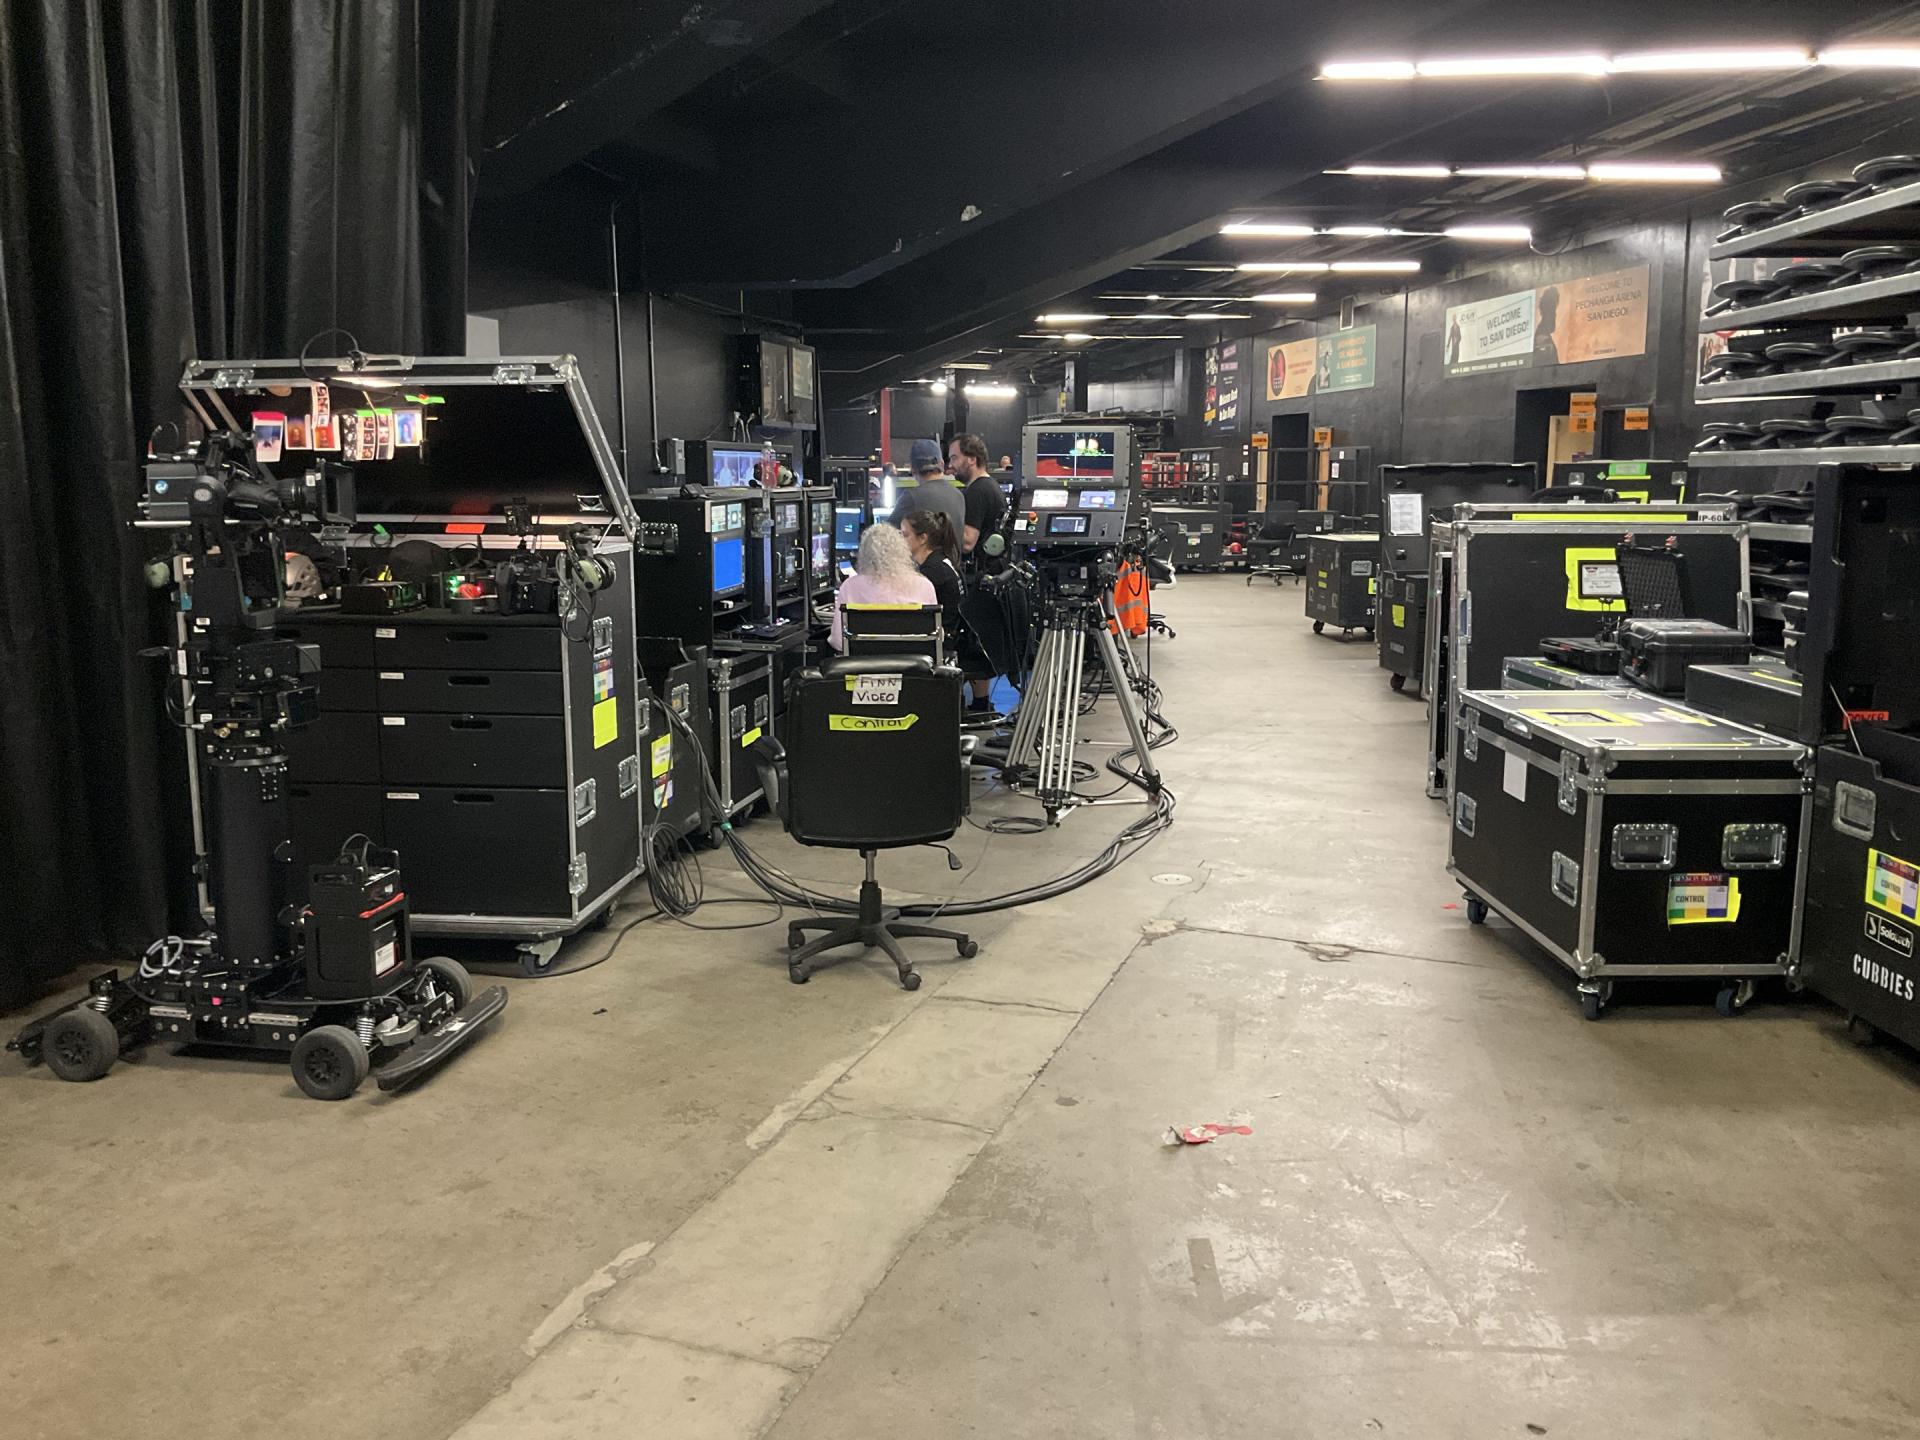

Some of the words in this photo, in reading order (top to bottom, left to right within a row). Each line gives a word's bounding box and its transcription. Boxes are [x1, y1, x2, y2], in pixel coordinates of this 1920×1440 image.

[1585, 281, 1620, 294] WELCOME
[1622, 277, 1632, 287] TO
[1575, 295, 1614, 309] PECHANGA
[1615, 290, 1641, 303] ARENA
[1486, 307, 1521, 331] WELCOME
[1587, 311, 1602, 322] SAN
[1479, 336, 1488, 348] TO
[1489, 328, 1504, 345] SAN
[1698, 514, 1722, 522] IP-60
[1675, 895, 1705, 903] CONTROL
[1853, 953, 1914, 1001] CUBBIES
